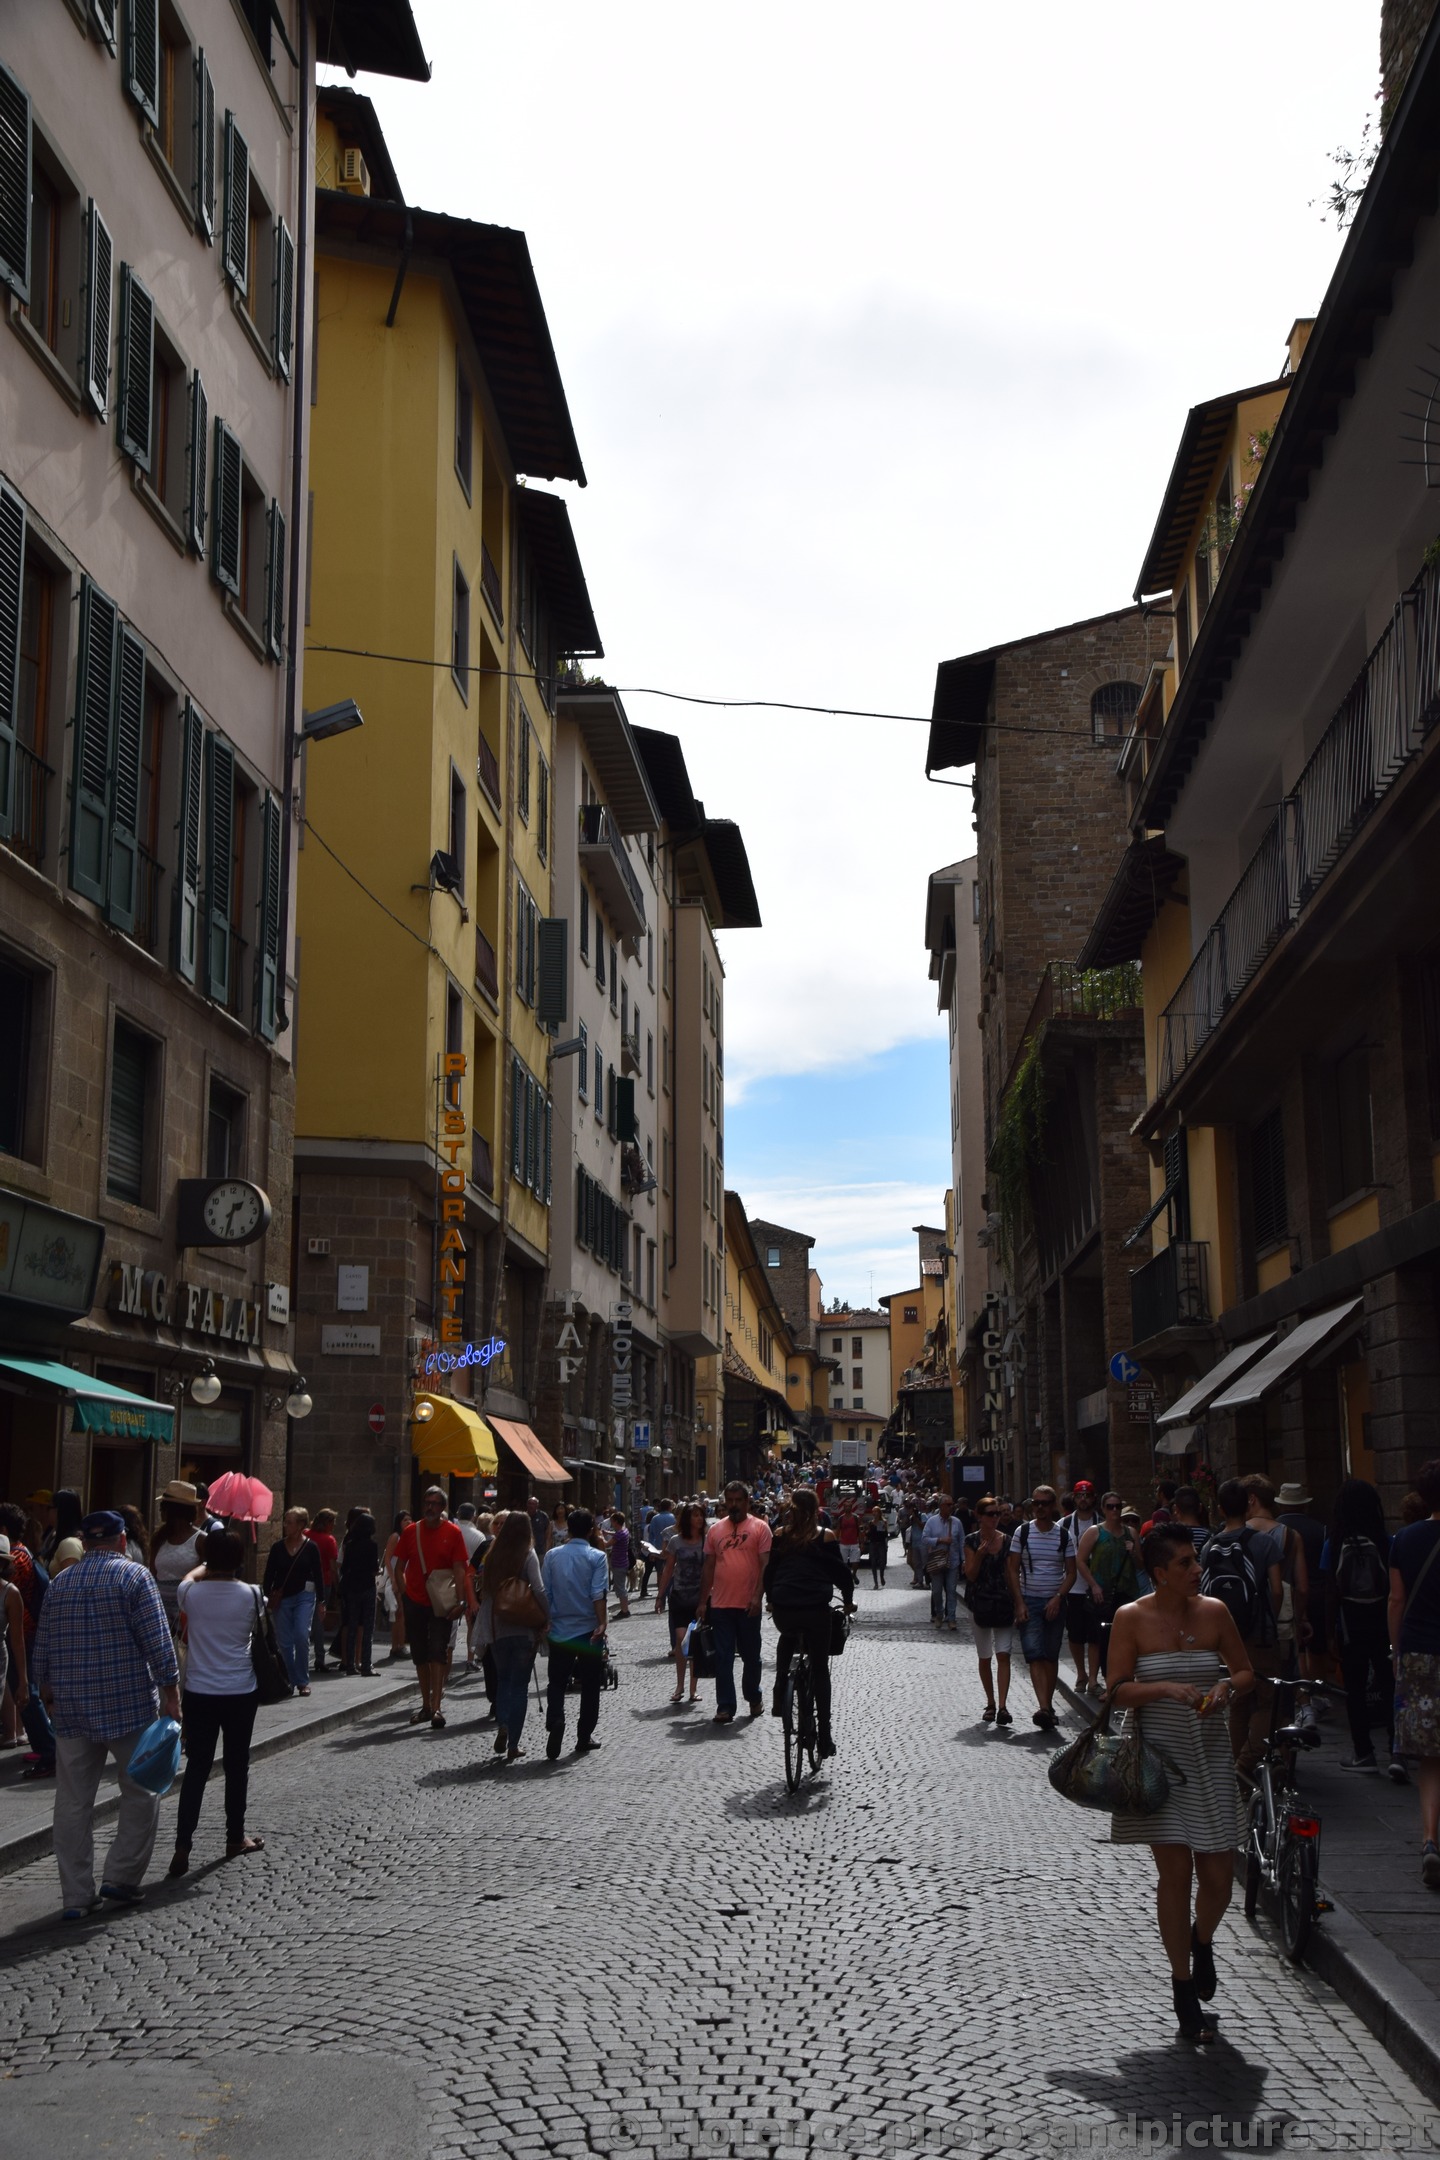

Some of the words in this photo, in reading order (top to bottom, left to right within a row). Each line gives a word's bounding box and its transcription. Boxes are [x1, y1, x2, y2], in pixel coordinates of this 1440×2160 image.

[440, 1053, 467, 1343] RISTORANTE
[118, 1262, 172, 1325] M.G.
[185, 1283, 262, 1346] FALAI
[555, 1289, 584, 1384] TAF
[612, 1301, 633, 1409] GLOVES
[982, 1291, 1003, 1432] PICCINI
[109, 1408, 146, 1428] RISTORANTE
[635, 1423, 649, 1441] T
[981, 1438, 1009, 1452] UGO
